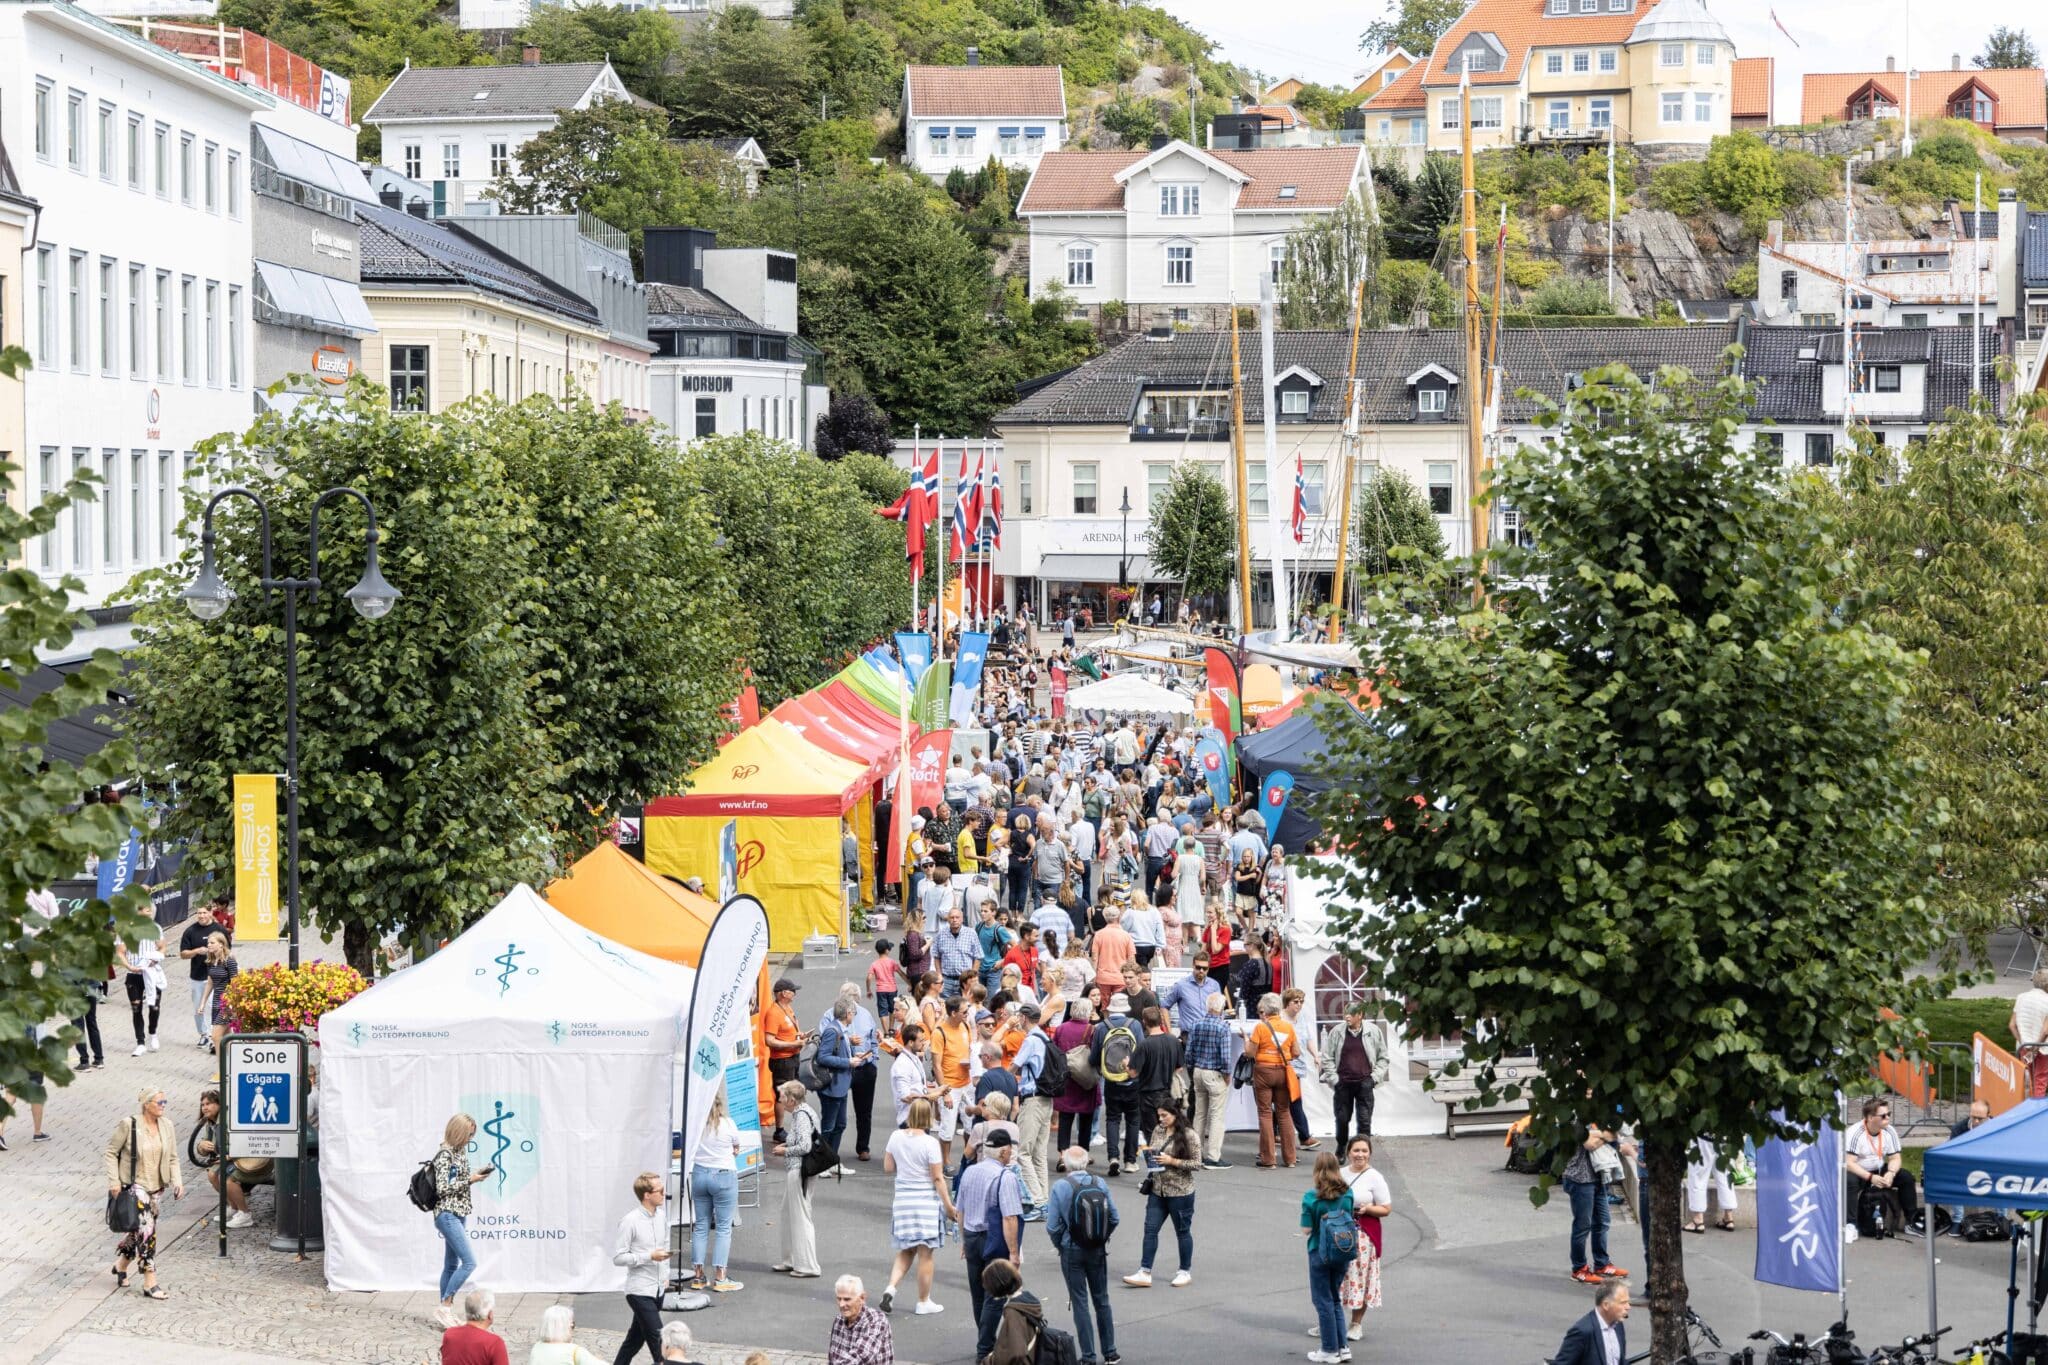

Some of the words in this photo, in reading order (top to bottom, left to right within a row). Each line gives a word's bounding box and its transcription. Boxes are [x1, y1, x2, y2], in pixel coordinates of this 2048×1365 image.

[1082, 533, 1128, 542] ARENDA
[910, 767, 940, 783] Rødt
[719, 800, 769, 810] www.krf.no
[716, 921, 762, 1038] OSTEOPATFORBUND
[709, 991, 729, 1033] NORSK
[371, 1031, 450, 1039] OSTEOPATFORBUND
[571, 1029, 650, 1037] OSTEOPATFORBUND
[242, 1048, 287, 1064] Sone
[246, 1074, 283, 1086] Gågate
[477, 1215, 520, 1226] NORSK
[438, 1230, 567, 1240] OOPATFORBUND
